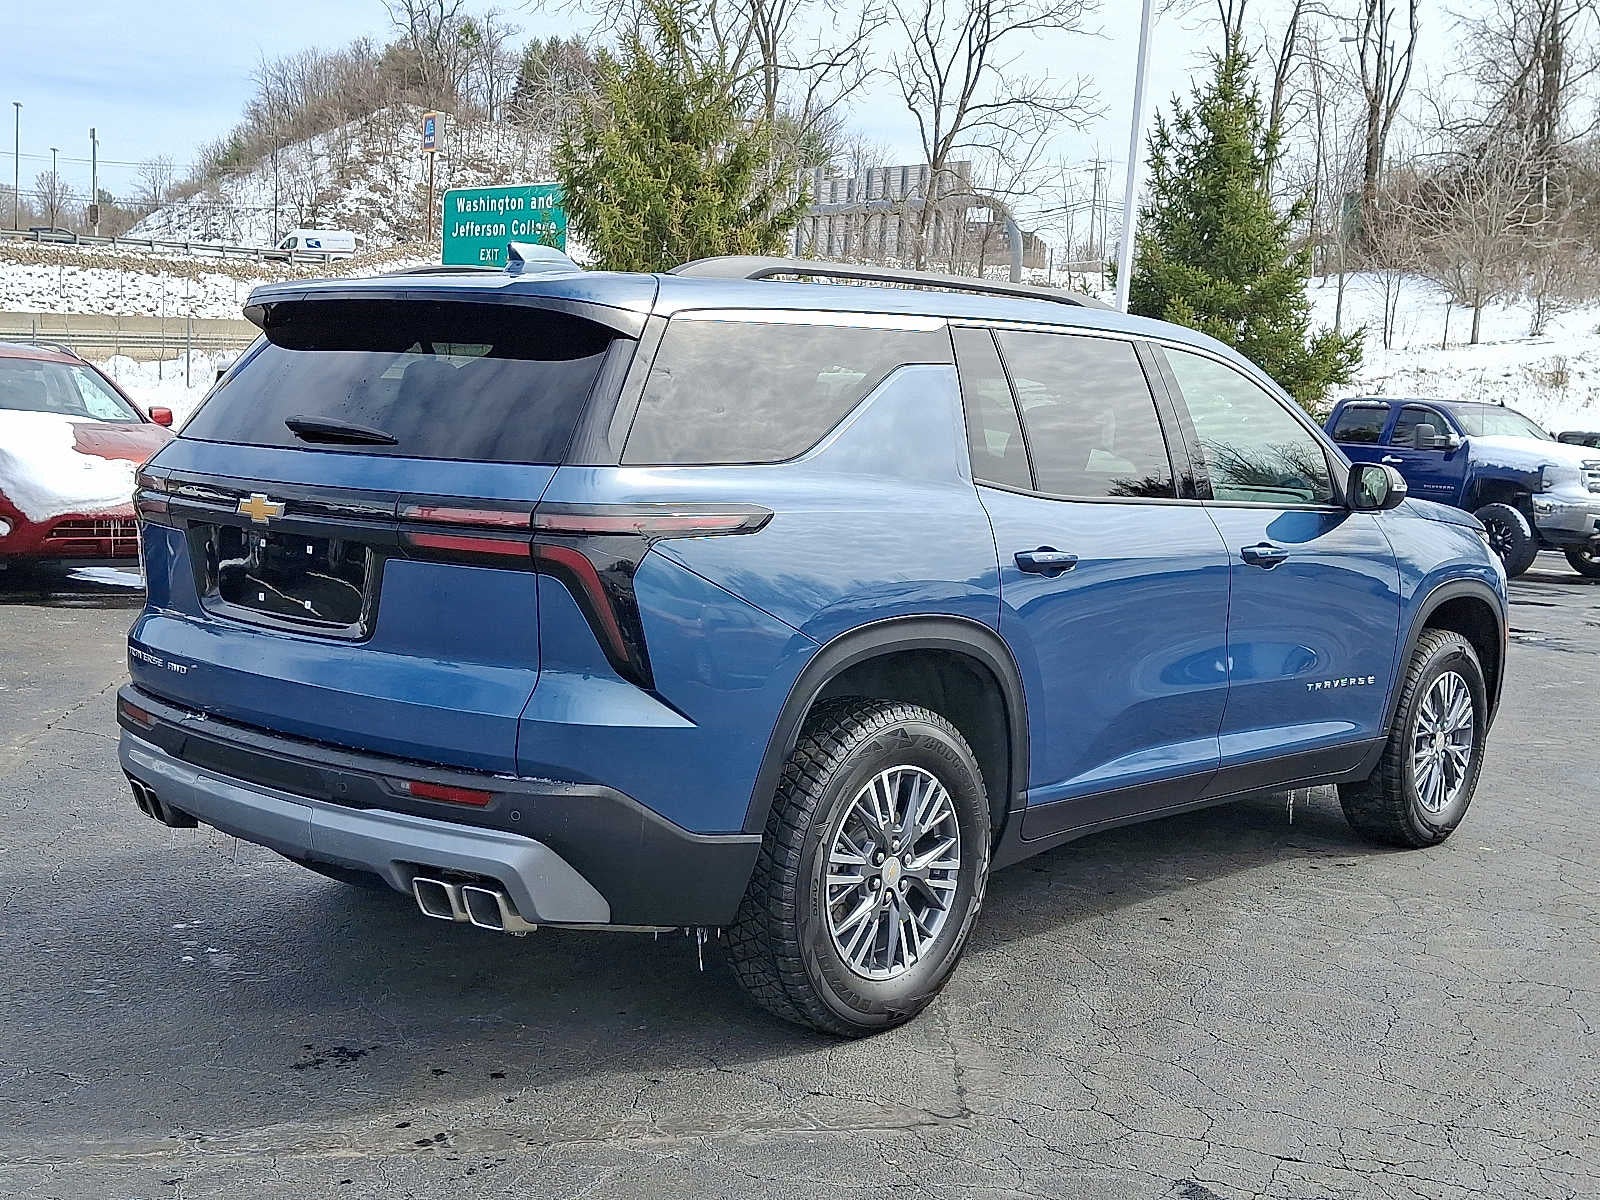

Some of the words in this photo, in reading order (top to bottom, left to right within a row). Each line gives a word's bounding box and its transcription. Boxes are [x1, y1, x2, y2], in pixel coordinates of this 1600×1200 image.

[456, 195, 524, 215] Washington
[530, 193, 553, 210] and
[451, 221, 506, 237] Jefferson
[479, 248, 500, 261] EXIT
[1306, 675, 1376, 692] TRAVERSE
